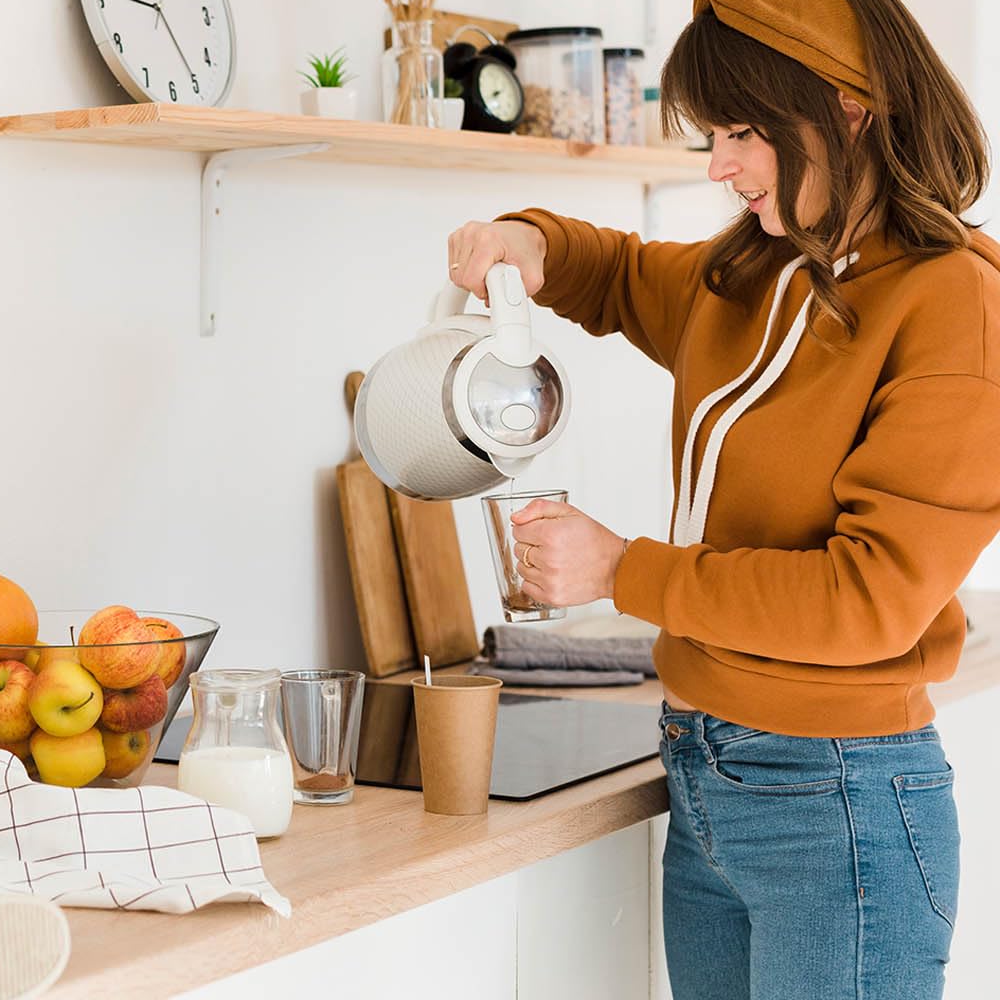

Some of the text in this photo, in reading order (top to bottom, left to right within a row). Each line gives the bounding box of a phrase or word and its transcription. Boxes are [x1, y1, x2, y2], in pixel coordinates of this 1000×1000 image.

[202, 6, 211, 26] 3
[113, 32, 124, 54] 8
[204, 47, 212, 67] 4
[142, 67, 150, 88] 7
[191, 74, 200, 94] 5
[168, 81, 178, 102] 6
